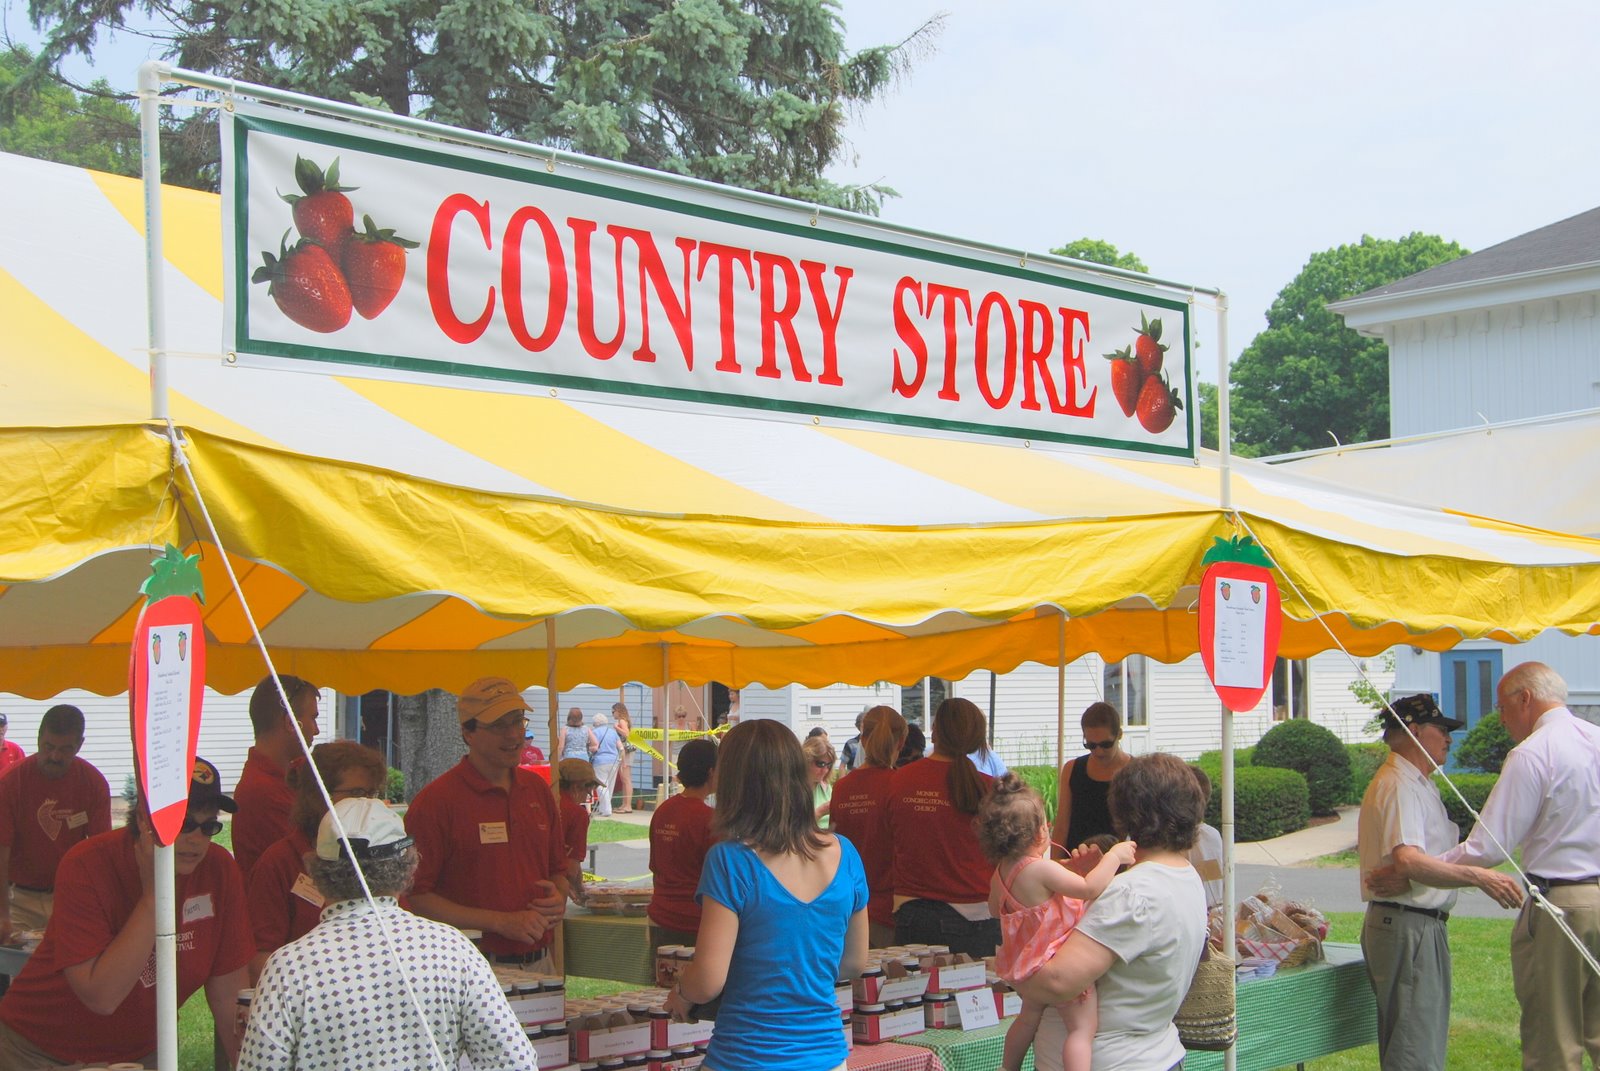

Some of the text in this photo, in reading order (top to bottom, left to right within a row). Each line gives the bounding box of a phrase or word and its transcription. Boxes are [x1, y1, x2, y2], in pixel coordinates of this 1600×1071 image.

[427, 193, 1097, 418] COUNTRY STORE
[903, 797, 951, 807] CONGREGATIONAL
